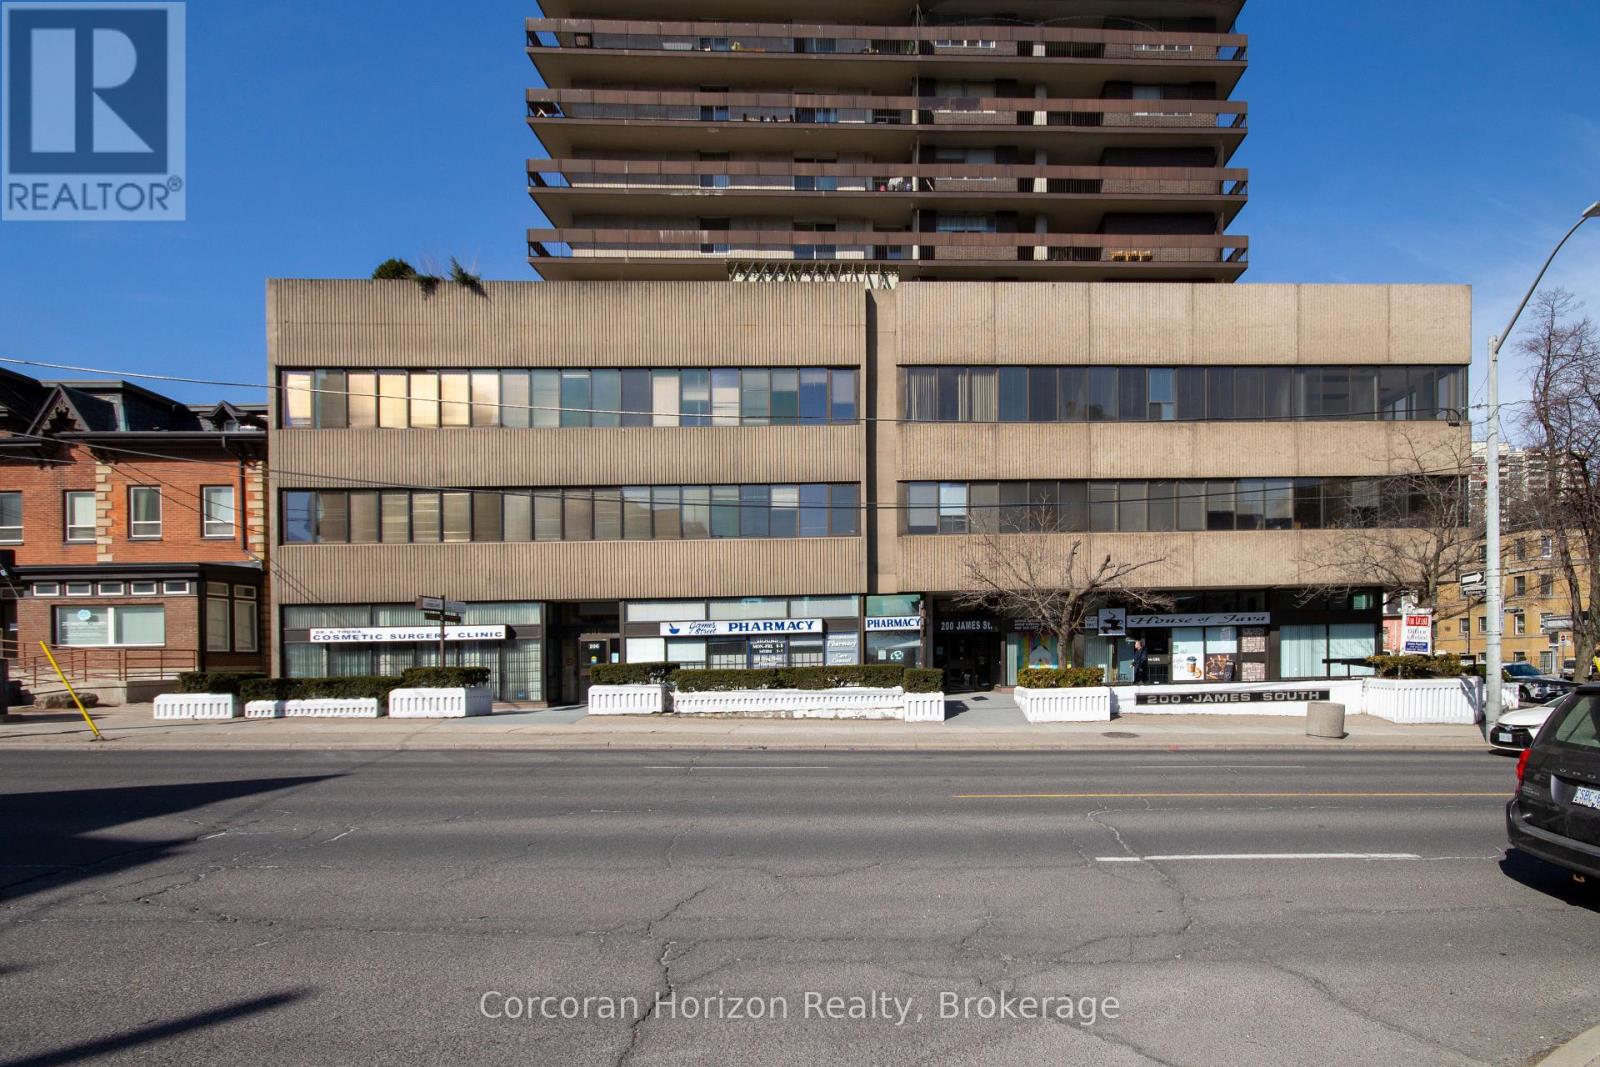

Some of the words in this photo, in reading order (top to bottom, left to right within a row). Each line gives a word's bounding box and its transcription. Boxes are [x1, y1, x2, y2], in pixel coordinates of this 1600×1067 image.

[867, 618, 920, 628] PHARMACY
[941, 621, 954, 630] 200
[956, 620, 980, 630] JAMES
[1130, 616, 1193, 625] House
[1197, 616, 1209, 624] of
[728, 621, 814, 632] PHARMACY
[1147, 695, 1181, 704] 200
[1192, 693, 1250, 703] JAMES
[1262, 691, 1320, 701] SOUTH
